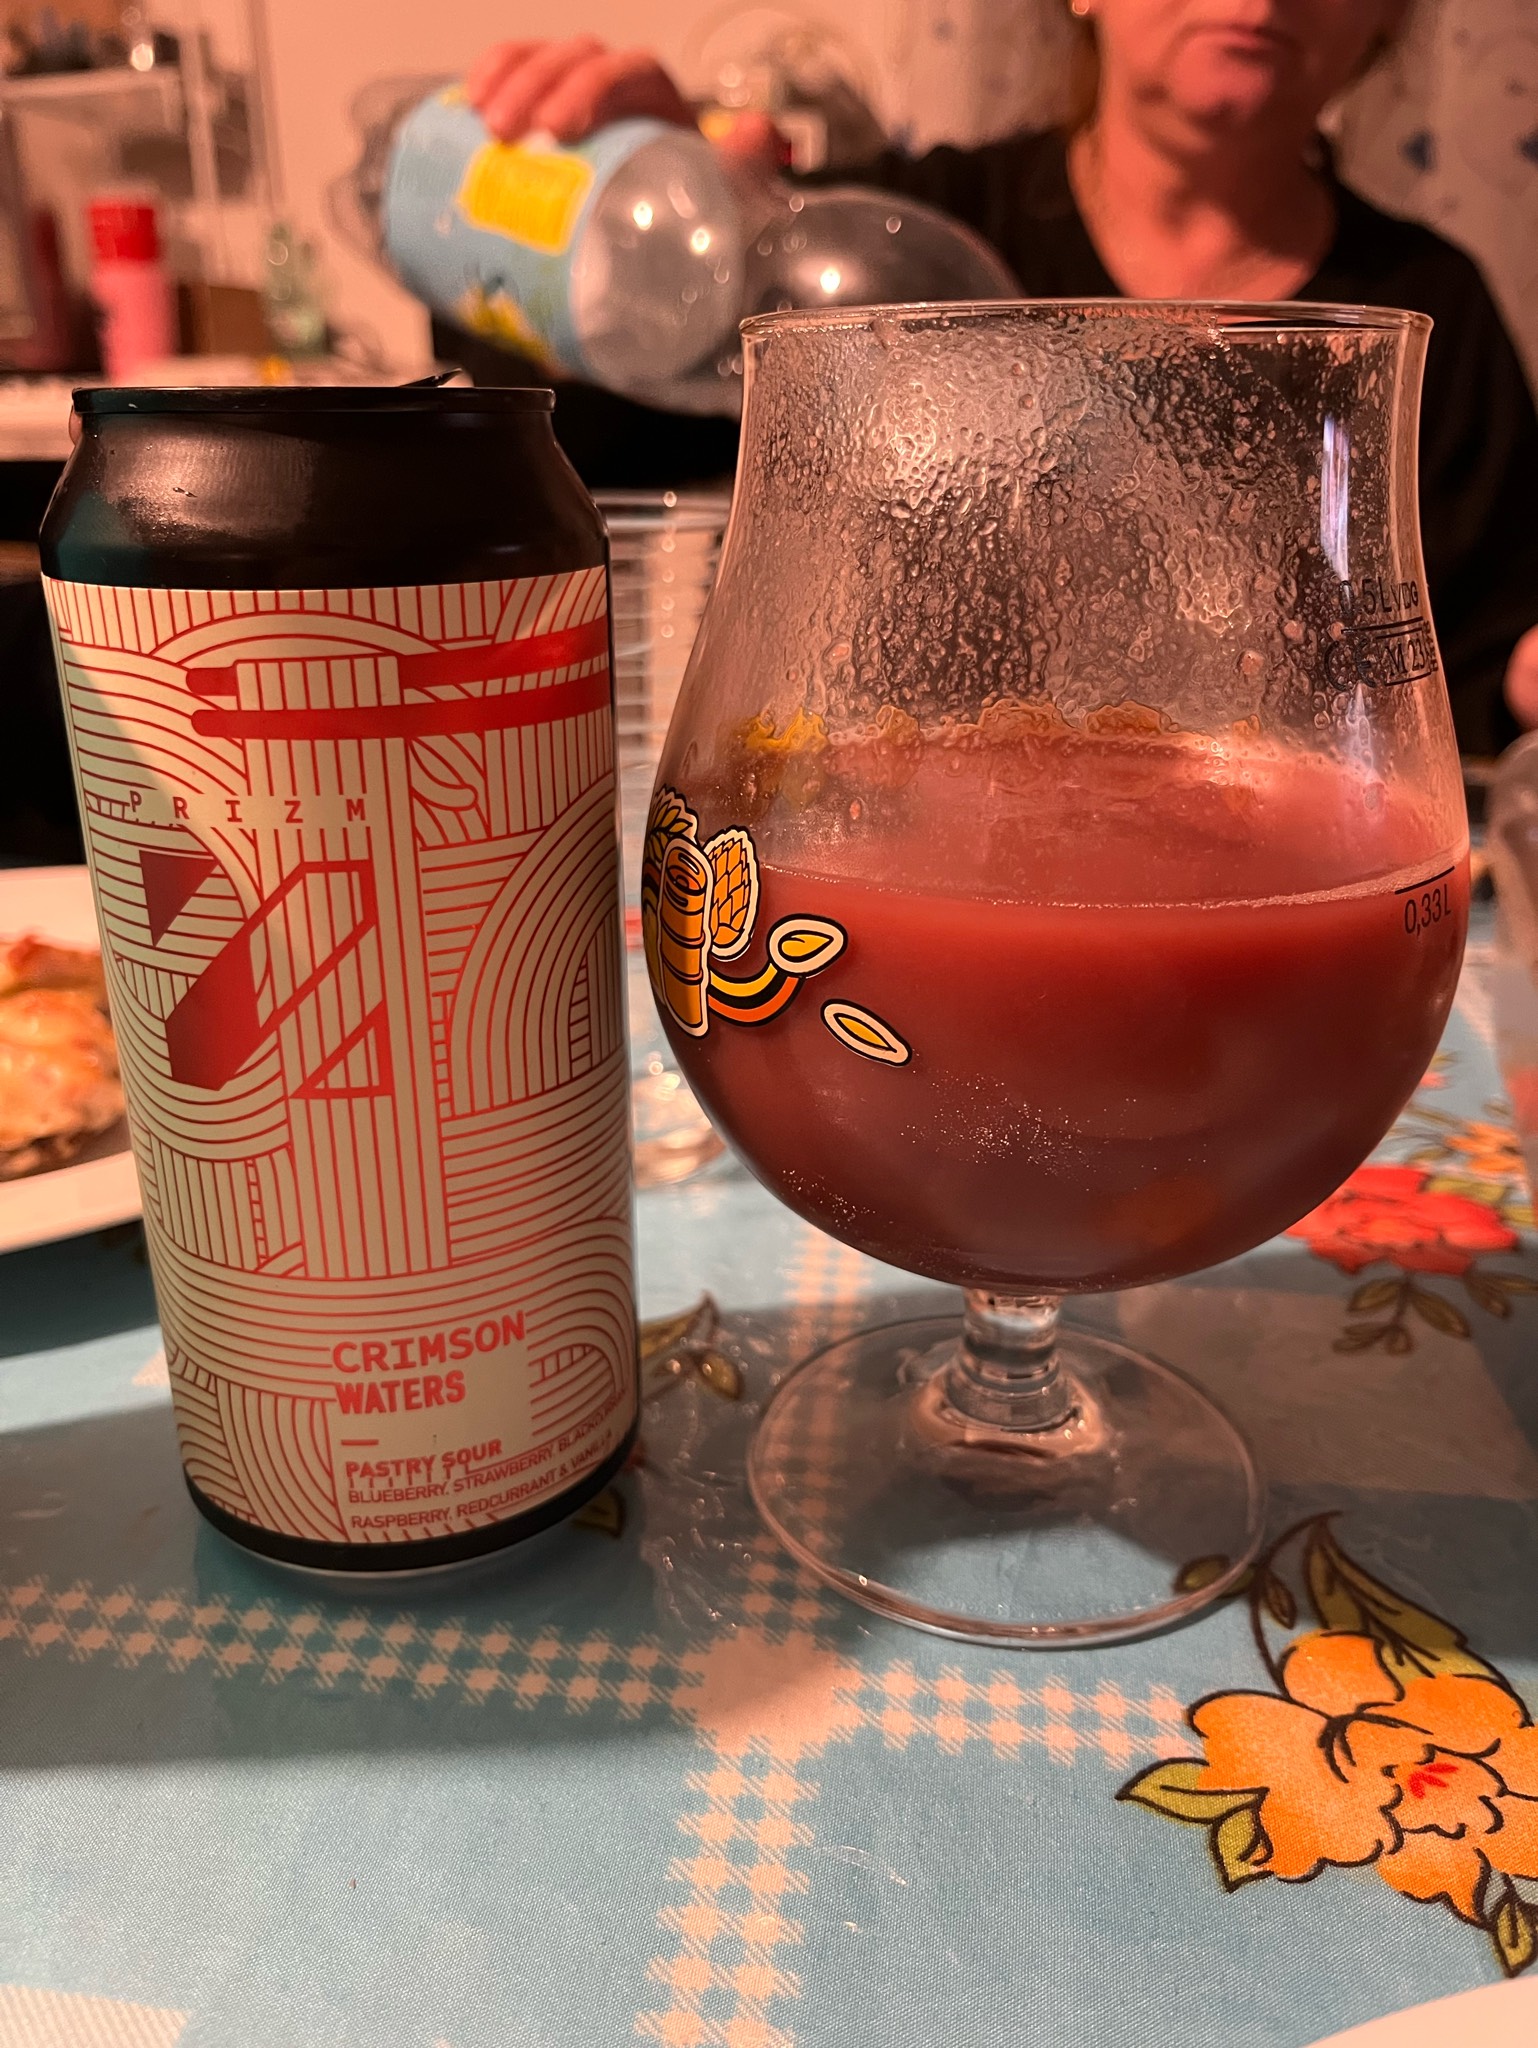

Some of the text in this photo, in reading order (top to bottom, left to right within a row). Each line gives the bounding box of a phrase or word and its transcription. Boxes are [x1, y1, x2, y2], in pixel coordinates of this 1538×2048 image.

[130, 790, 367, 824] PRIZM
[333, 1310, 526, 1373] CRIMSON
[336, 1370, 466, 1415] WATERS
[345, 1439, 502, 1478] PASTRY SOUR
[457, 1467, 557, 1517] REDCURRANT
[559, 1462, 569, 1477] &
